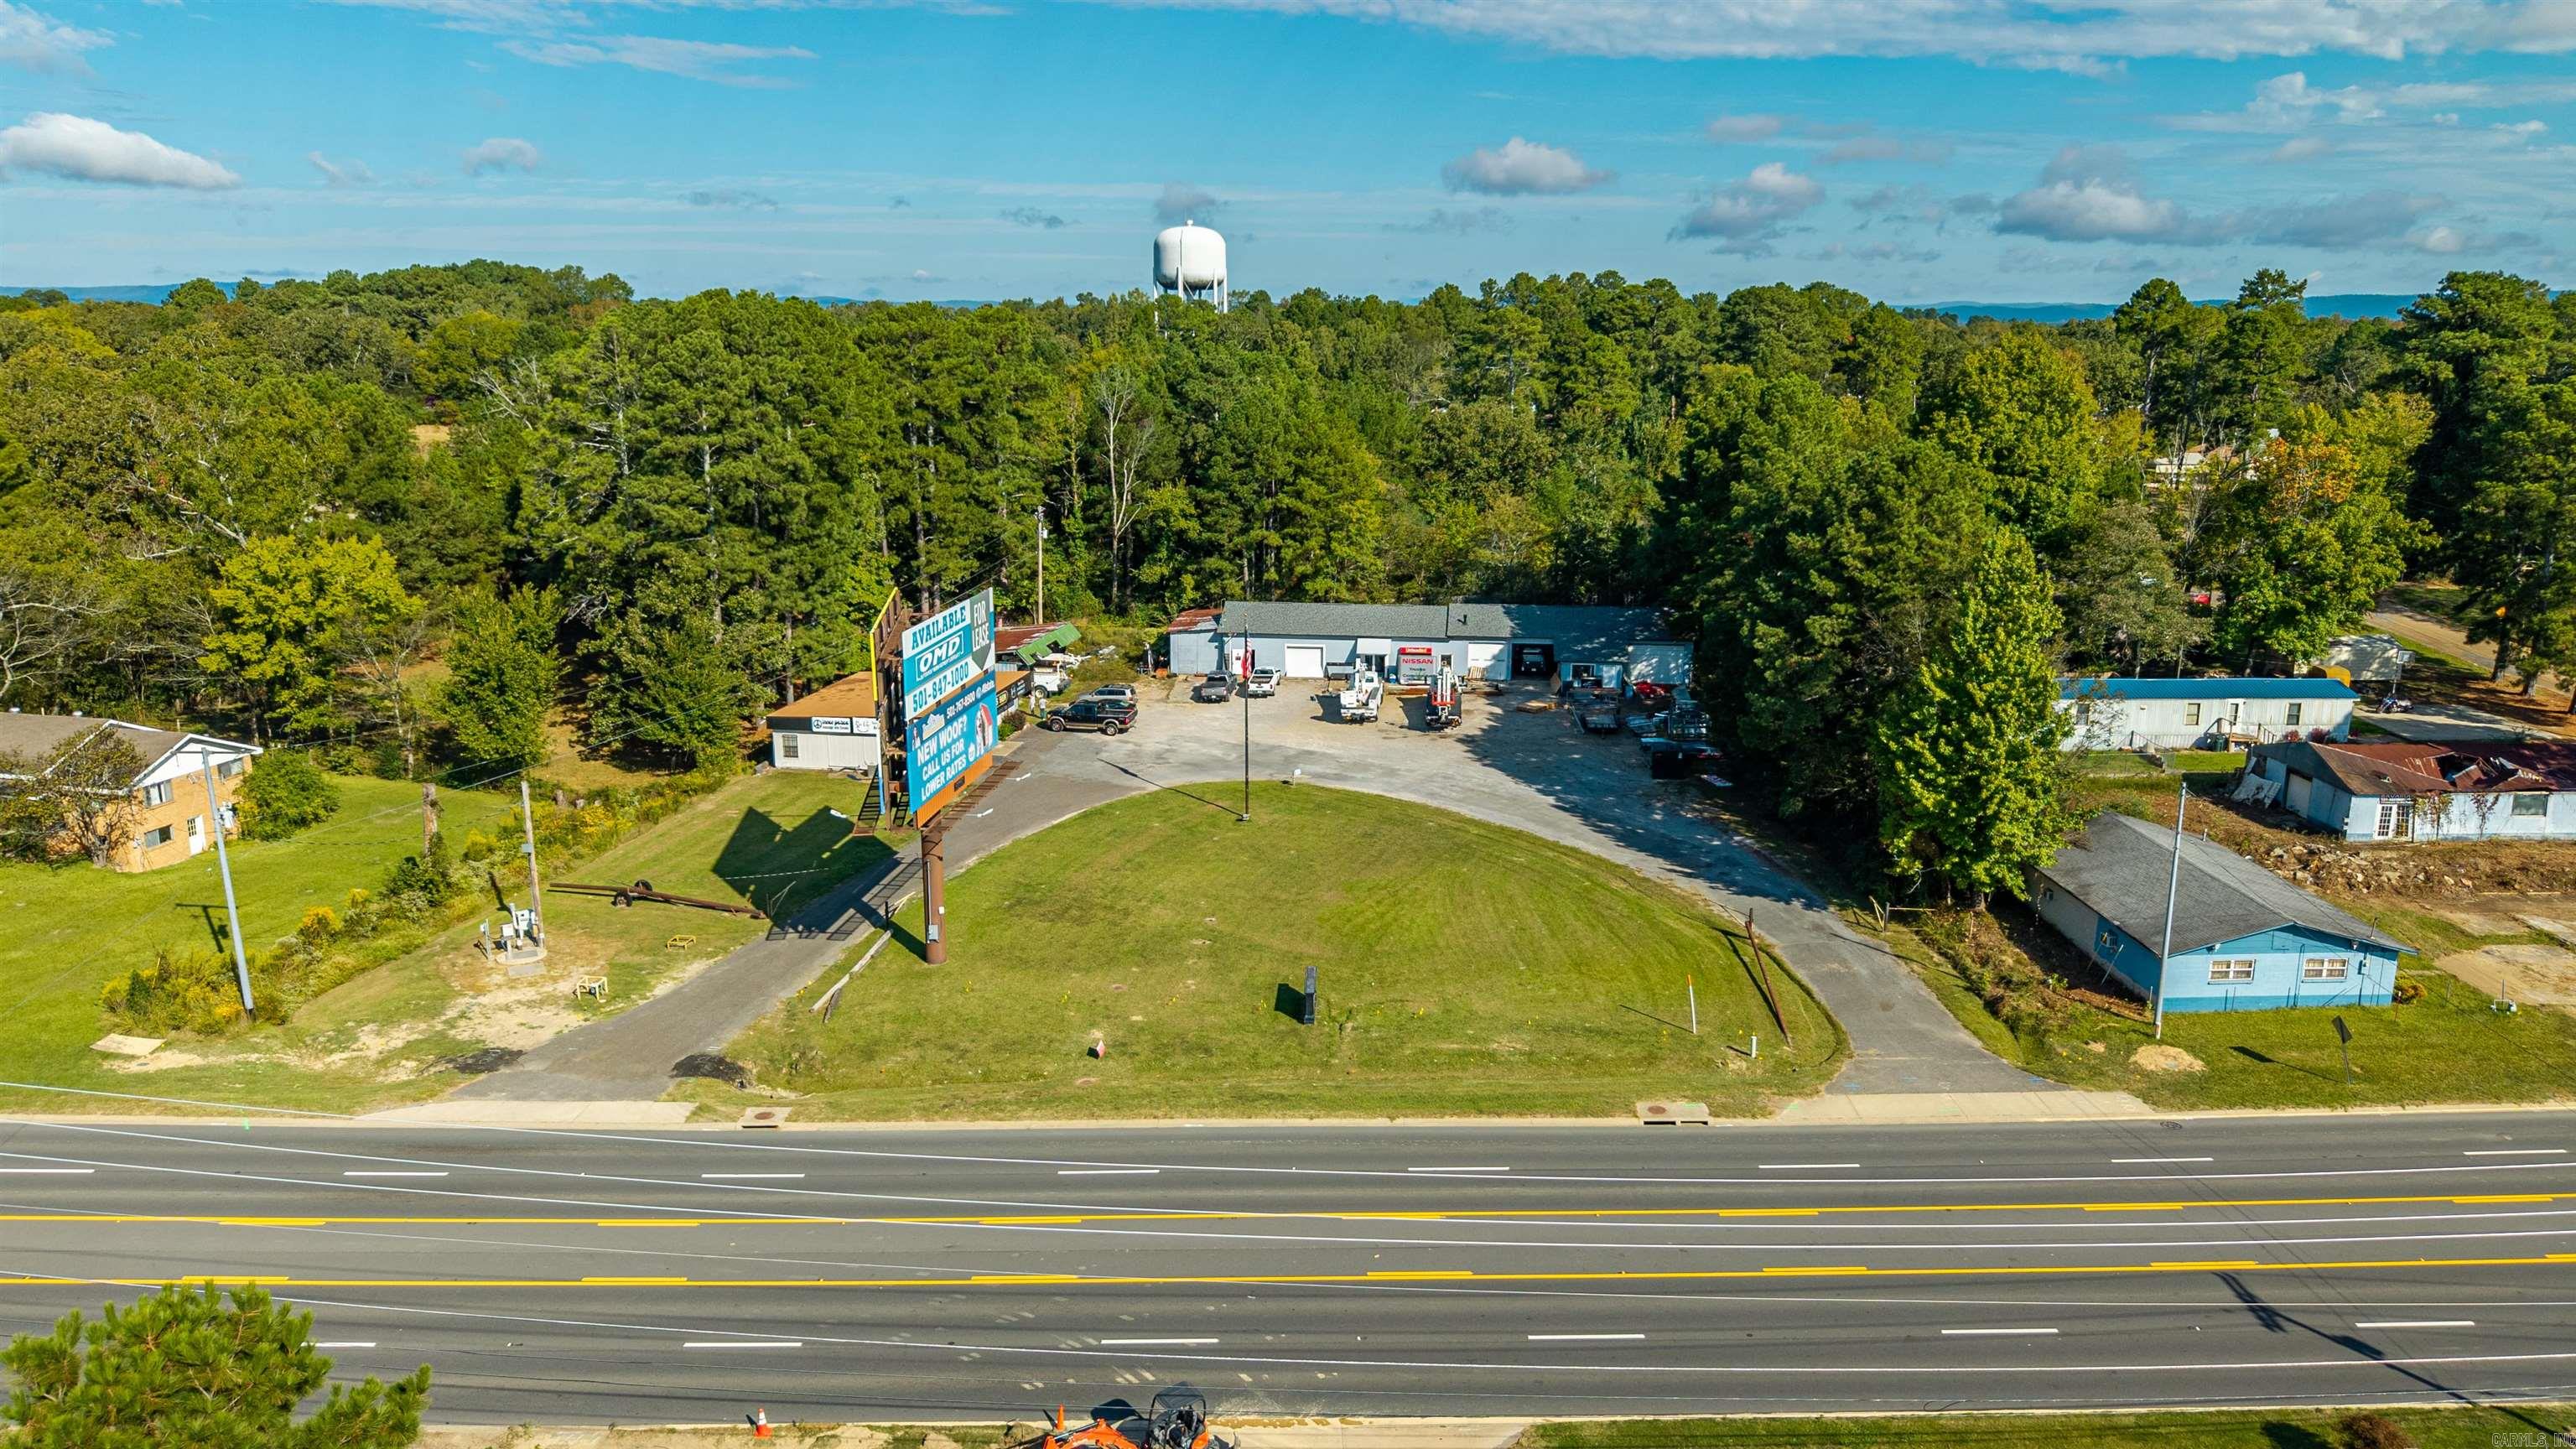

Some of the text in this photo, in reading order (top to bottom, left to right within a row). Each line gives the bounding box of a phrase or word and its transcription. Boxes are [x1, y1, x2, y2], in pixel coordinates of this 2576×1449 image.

[911, 605, 966, 651] AVAILABLE
[974, 600, 987, 626] FOR
[919, 636, 961, 673] OMD
[973, 622, 989, 652] LEASE
[912, 661, 969, 712] 501-847-1000
[917, 736, 937, 766] NEW
[939, 714, 968, 749] WOOF?
[922, 738, 964, 781] CALL US FOR
[921, 771, 945, 802] LOWER
[946, 754, 967, 781] RATES
